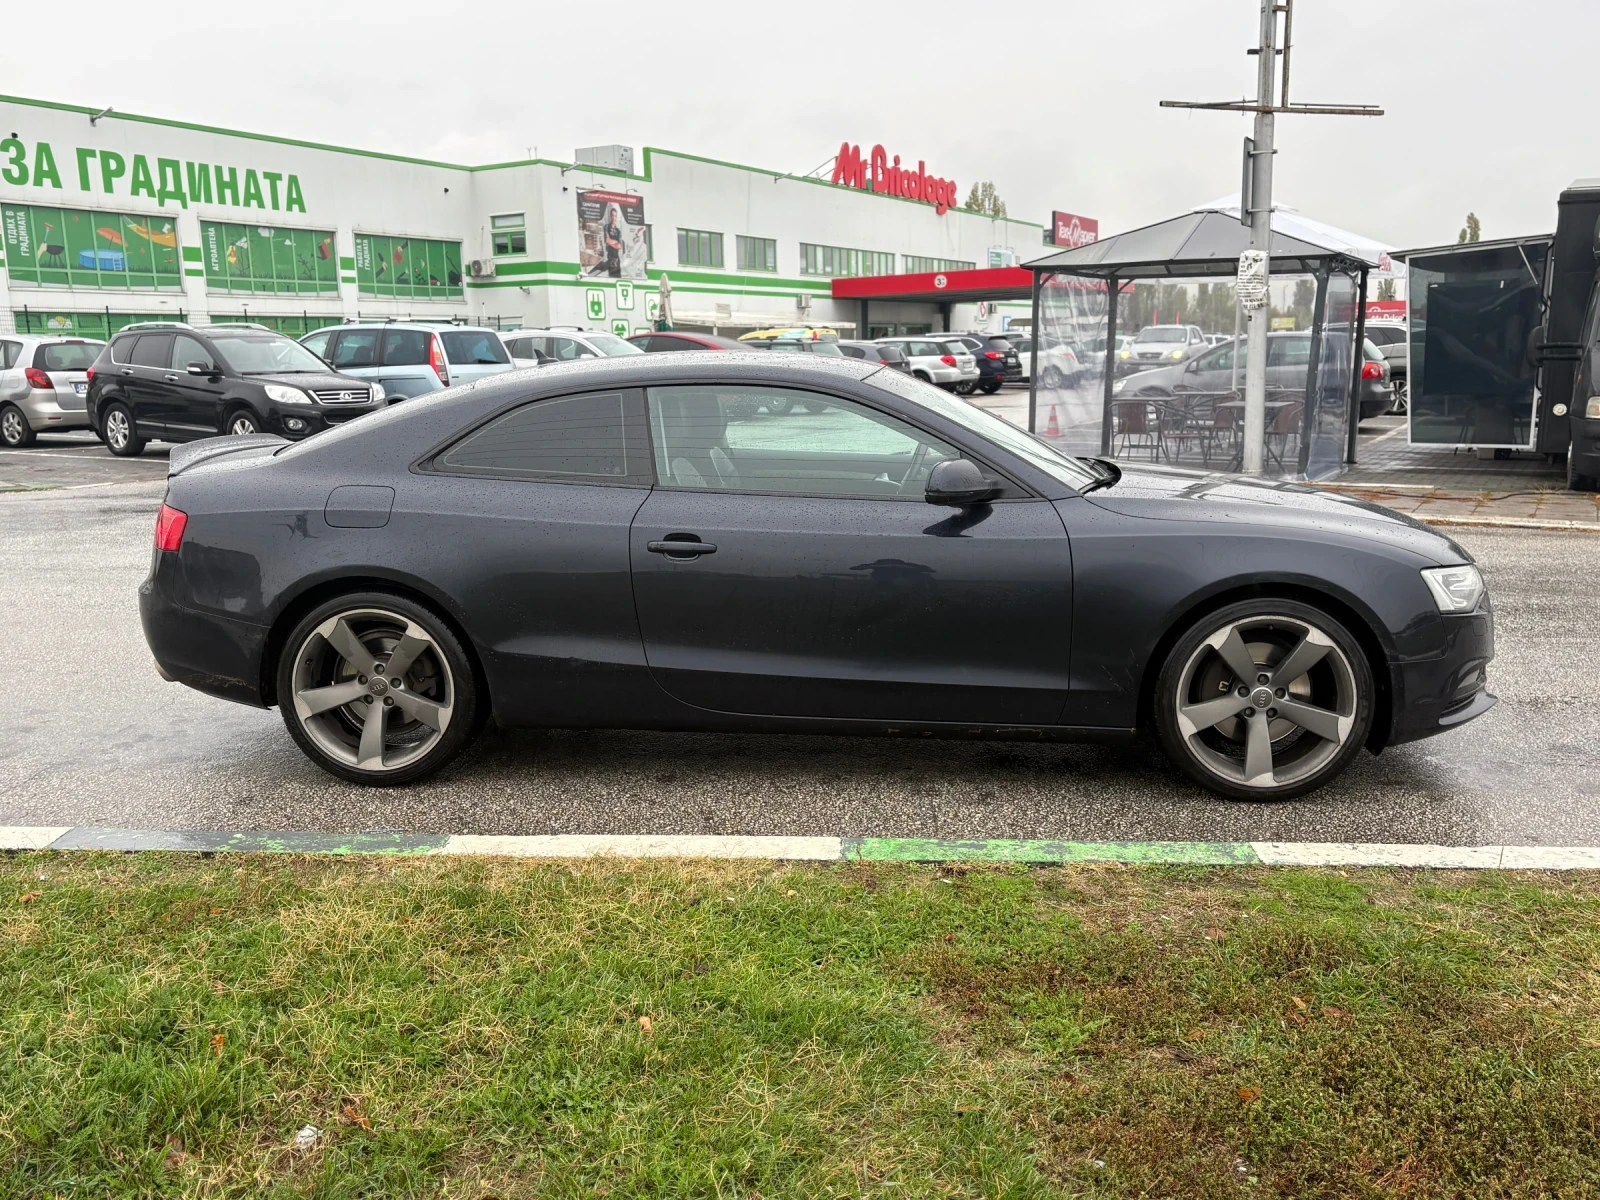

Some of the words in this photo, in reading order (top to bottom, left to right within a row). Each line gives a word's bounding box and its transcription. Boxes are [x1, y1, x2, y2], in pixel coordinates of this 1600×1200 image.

[0, 138, 62, 189] ЗА
[75, 147, 307, 213] ГРАДИНАТА
[6, 218, 17, 244] ОТДИХ
[16, 212, 30, 256] ГРАДИНАТА
[208, 227, 219, 271] АГРОАПТЕКА
